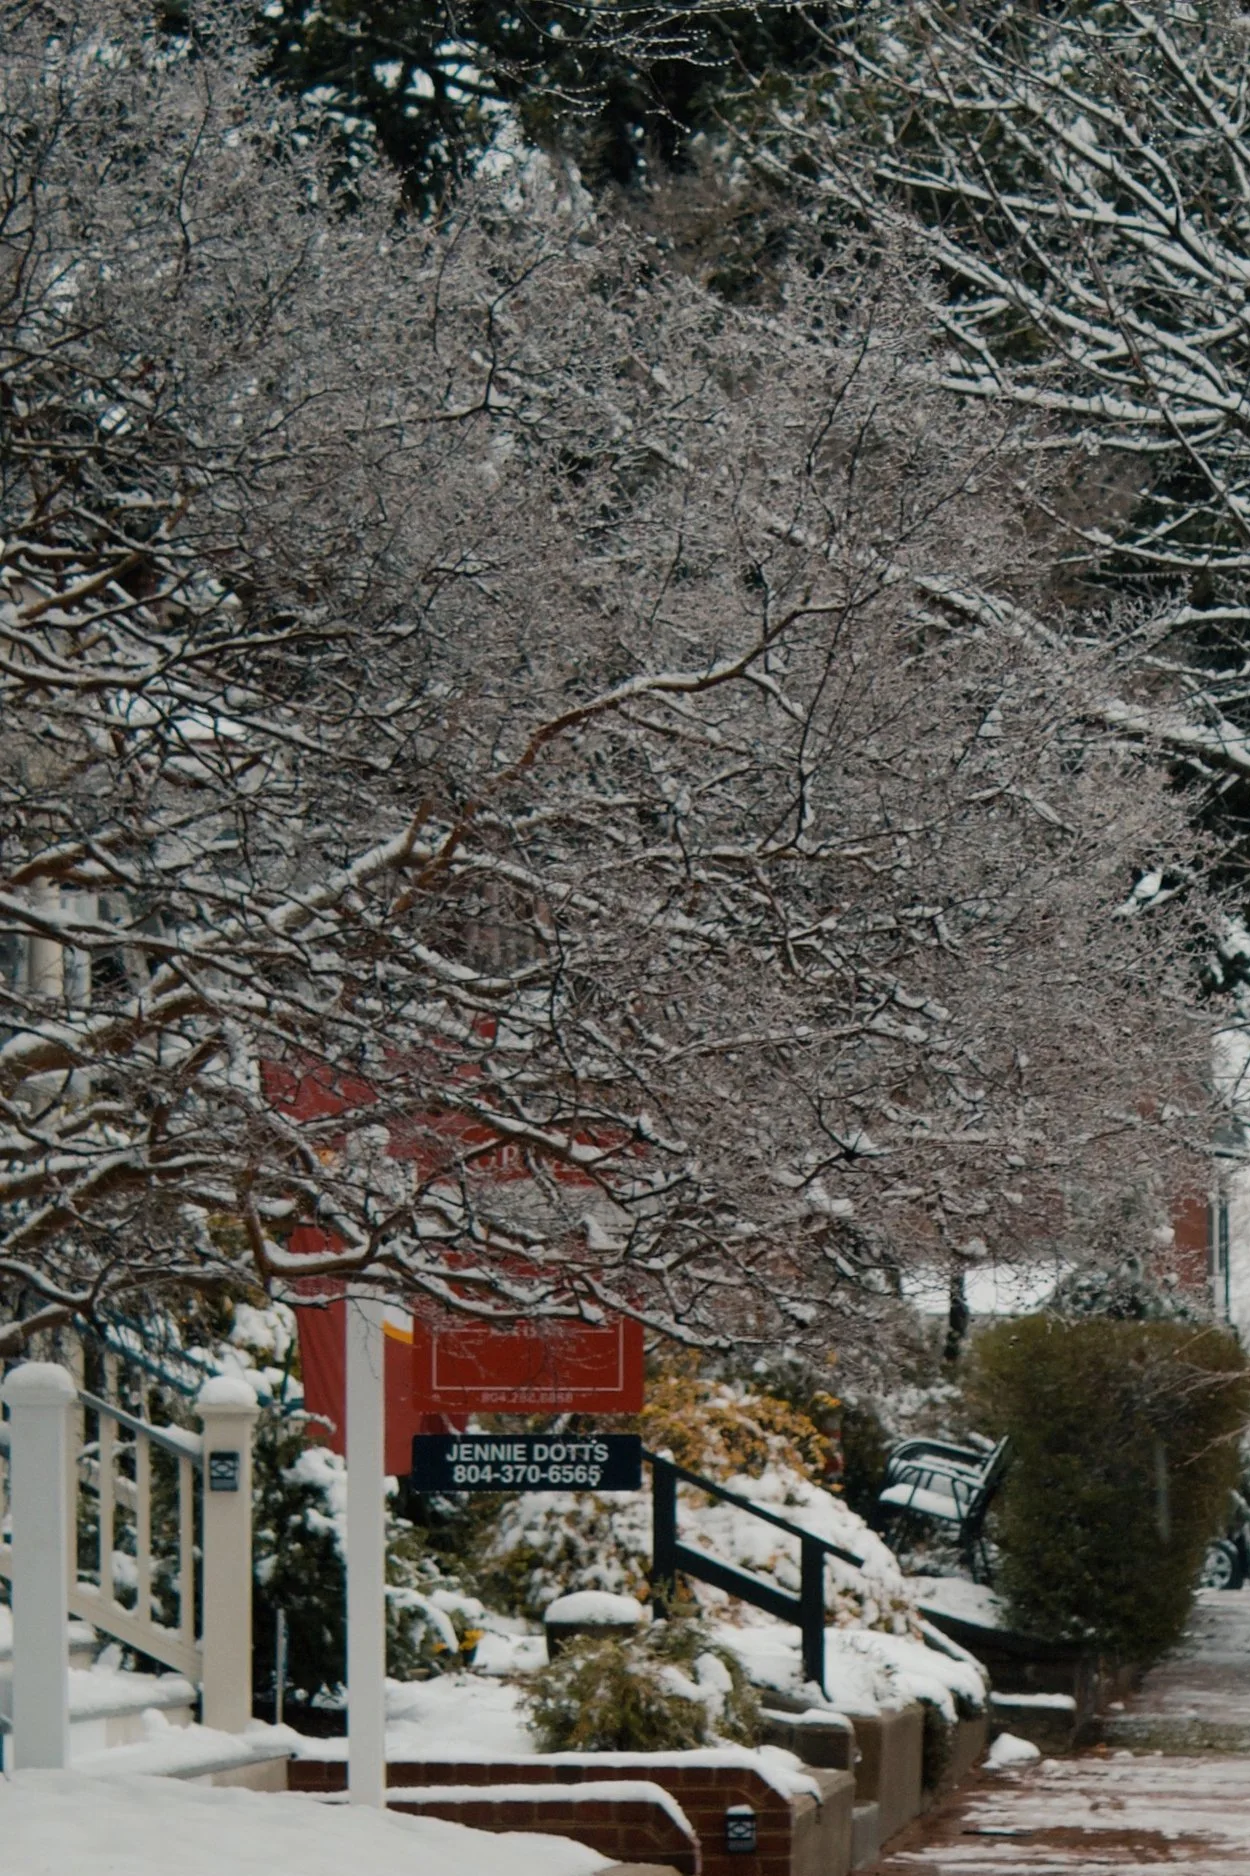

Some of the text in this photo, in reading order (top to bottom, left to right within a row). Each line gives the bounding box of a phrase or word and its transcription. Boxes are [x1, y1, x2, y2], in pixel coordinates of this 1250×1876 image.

[445, 1443, 609, 1463] JENNIE DOTTS
[453, 1465, 600, 1485] 804-370-6565
